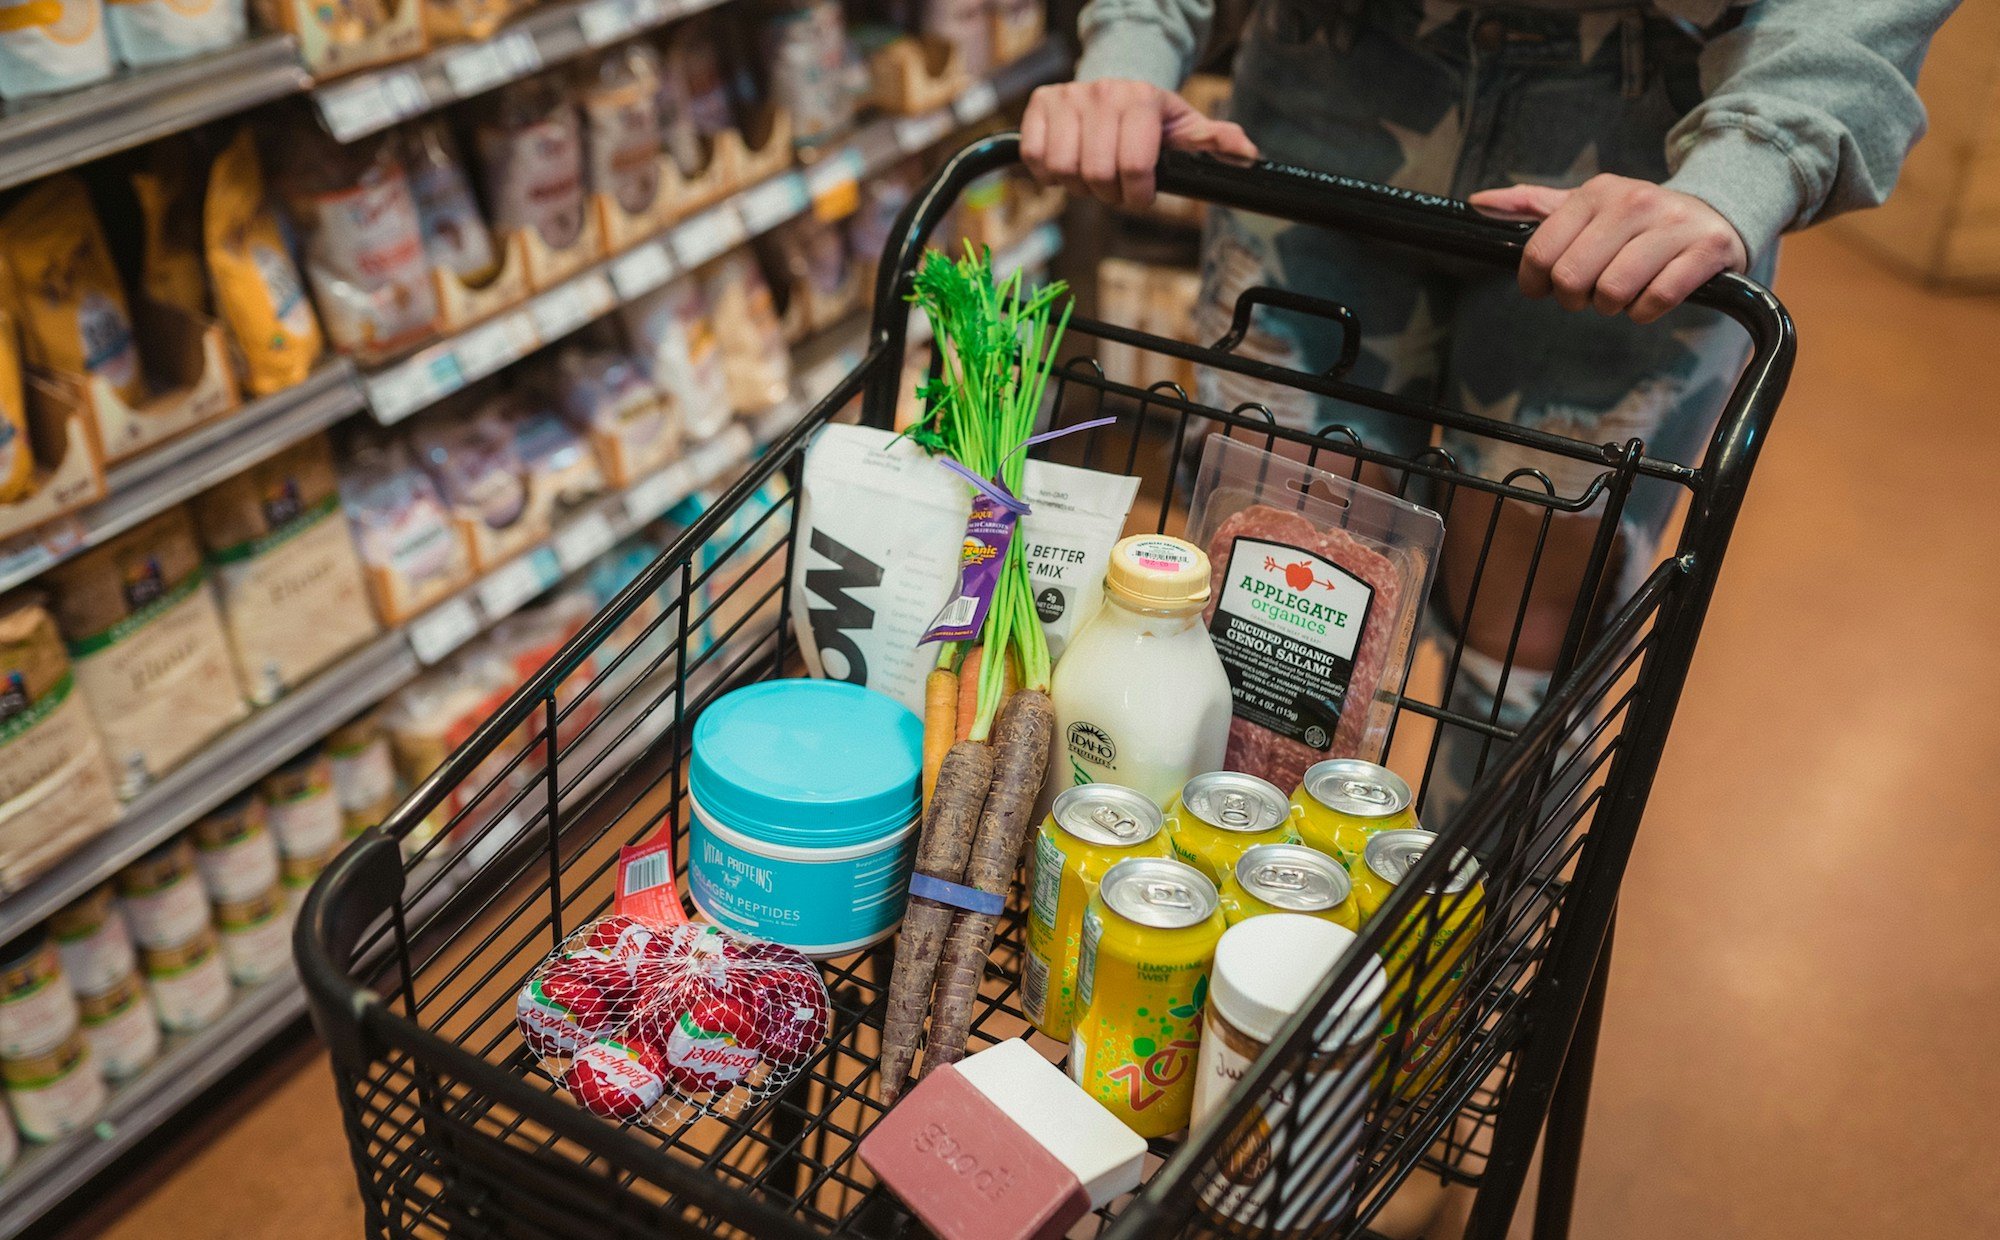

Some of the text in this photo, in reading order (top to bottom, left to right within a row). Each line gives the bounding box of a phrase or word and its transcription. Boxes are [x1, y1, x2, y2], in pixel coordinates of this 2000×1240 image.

[1033, 545, 1086, 564] BETTER
[1046, 592, 1057, 604] 2g
[1239, 575, 1349, 628] APPLEGATE
[1226, 629, 1332, 678] GENOA SALAMI
[1230, 618, 1335, 666] UNCURED ORGANIC
[1238, 652, 1248, 660] sea
[1247, 656, 1258, 664] salt
[1257, 660, 1268, 668] and
[1267, 664, 1290, 677] cultured
[1289, 673, 1306, 685] celery
[1305, 680, 1320, 690] juice
[1261, 655, 1278, 666] added
[1277, 663, 1296, 674] except
[1295, 668, 1304, 676] for
[1304, 672, 1320, 682] those
[1241, 680, 1255, 690] KEEP
[1284, 688, 1297, 697] FREE
[1232, 687, 1245, 698] NET
[1245, 692, 1257, 705] WT.
[1258, 699, 1264, 708] 4
[1276, 705, 1299, 722] (113g)
[703, 839, 724, 866] VITAL
[727, 857, 773, 893] PROTEINS
[737, 895, 800, 921] PEPTIDES
[1137, 962, 1175, 972] LEMON
[1137, 972, 1171, 983] TWIST
[583, 1047, 653, 1090] Babybel
